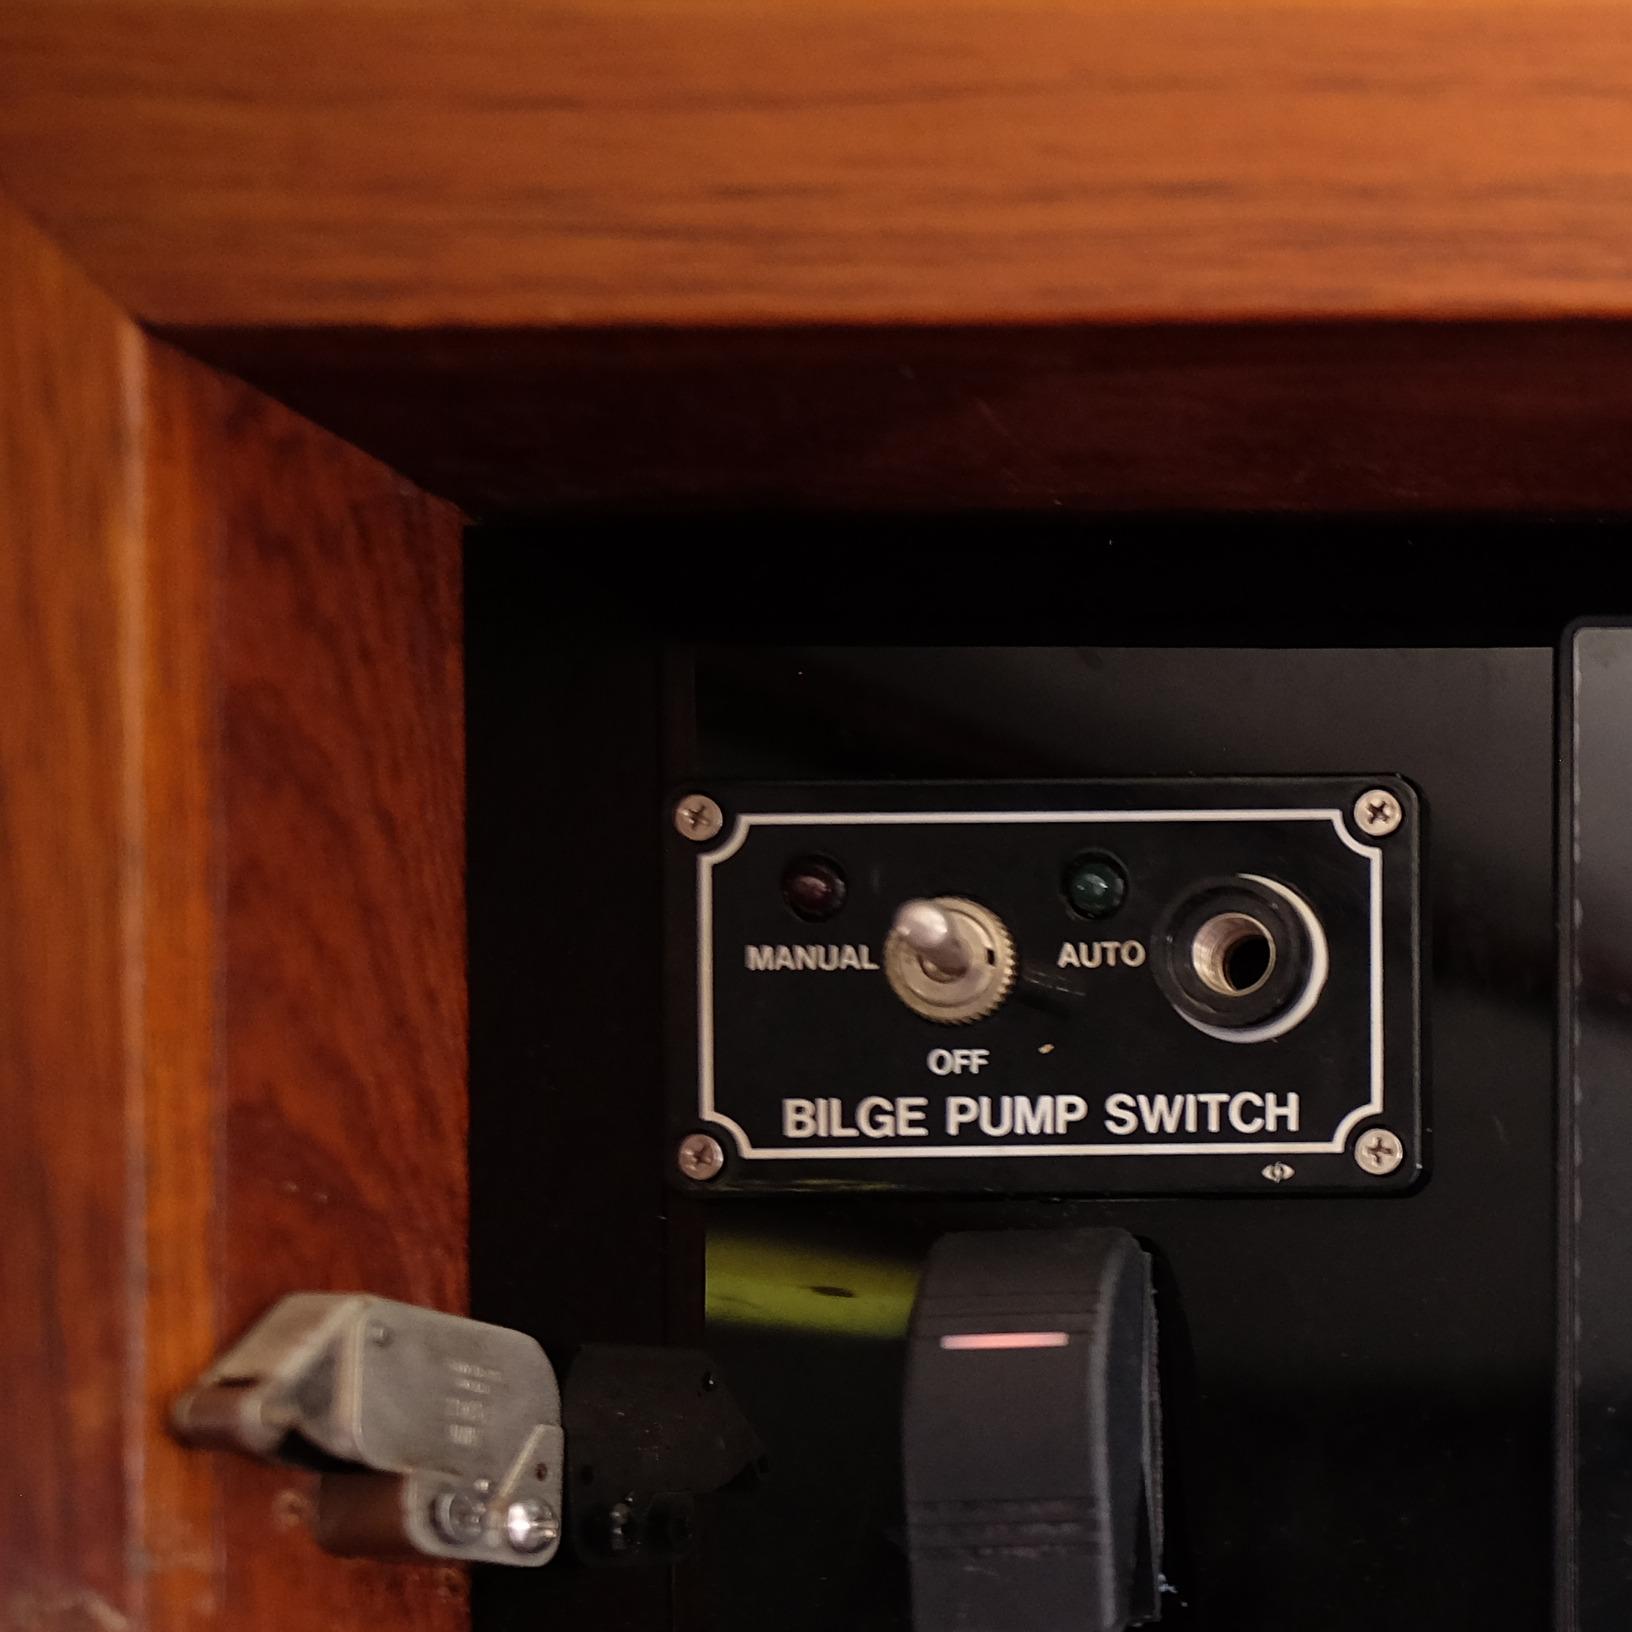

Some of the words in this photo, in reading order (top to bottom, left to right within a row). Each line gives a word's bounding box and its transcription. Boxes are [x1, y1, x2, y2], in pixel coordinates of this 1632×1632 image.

[745, 944, 879, 972] MANUAL
[1058, 941, 1146, 968] AUTO
[927, 1049, 989, 1075] OFF
[782, 1097, 929, 1138] BILGE
[946, 1095, 1089, 1135] PUMP
[1105, 1092, 1300, 1134] SWITCH
